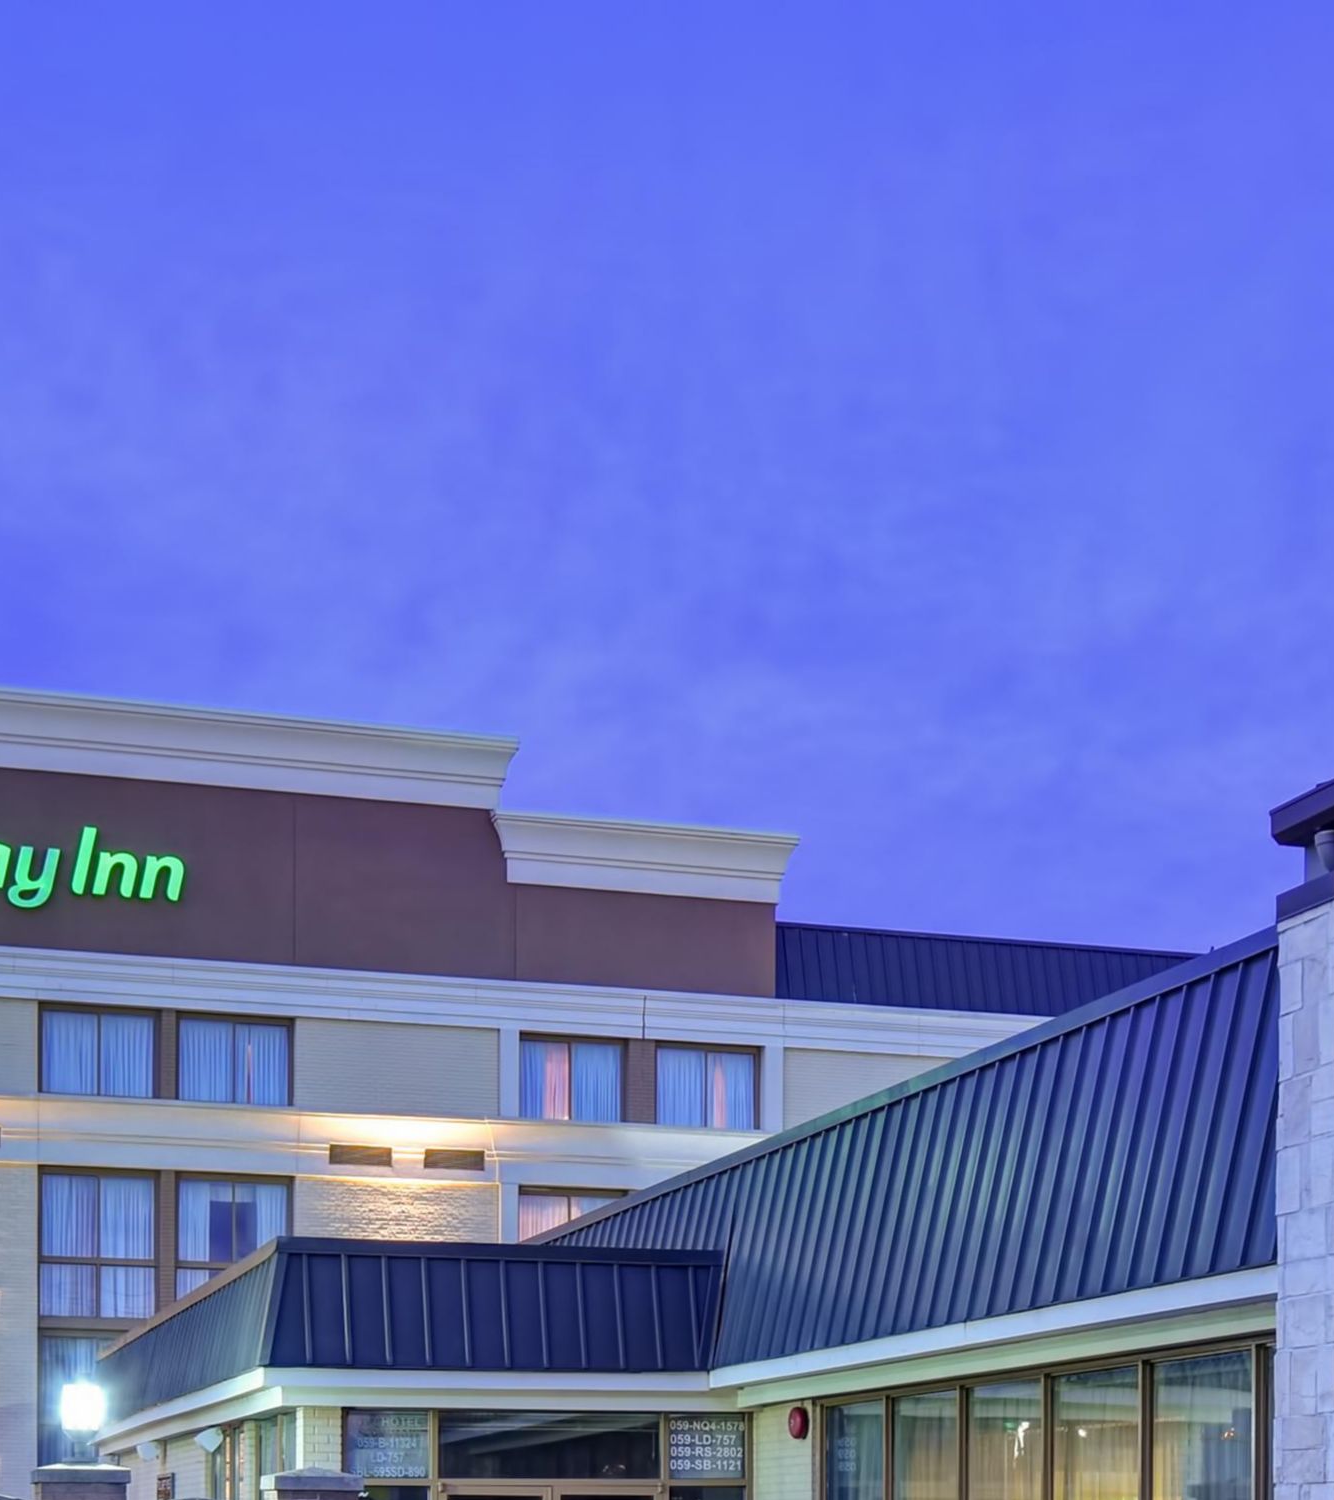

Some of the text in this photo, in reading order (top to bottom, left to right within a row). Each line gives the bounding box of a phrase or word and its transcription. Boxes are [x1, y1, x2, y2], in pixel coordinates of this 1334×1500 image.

[71, 827, 185, 902] Inn
[669, 1420, 745, 1431] 059-NQ4-1578
[670, 1434, 736, 1445] 059-LD-757
[670, 1446, 743, 1457] 059-RS-2802
[670, 1459, 742, 1471] 059-SB-1121
